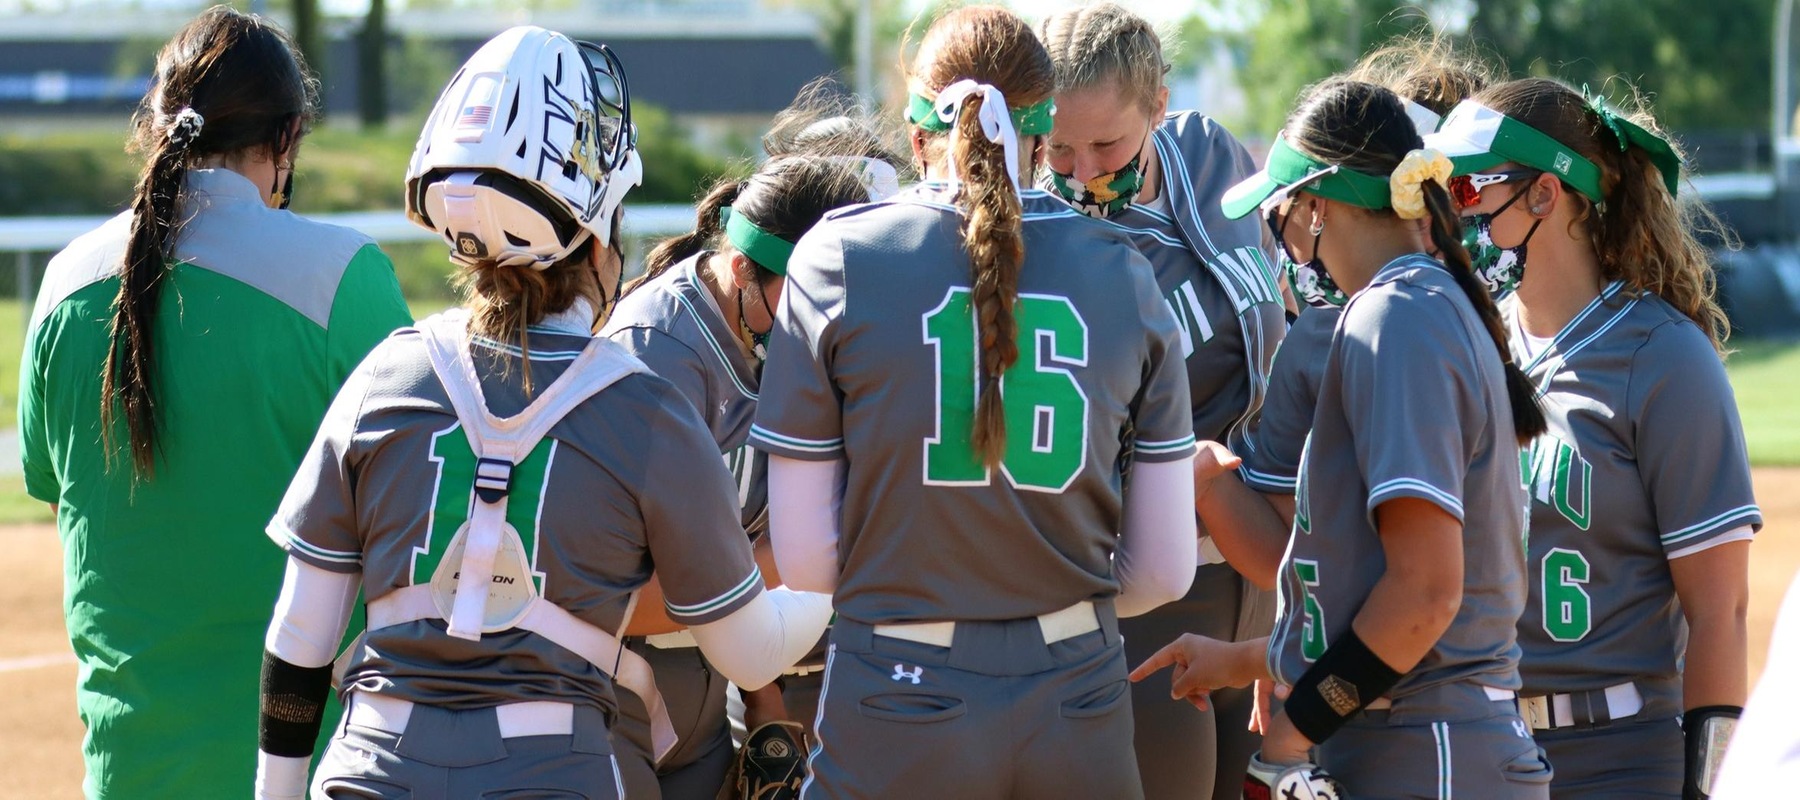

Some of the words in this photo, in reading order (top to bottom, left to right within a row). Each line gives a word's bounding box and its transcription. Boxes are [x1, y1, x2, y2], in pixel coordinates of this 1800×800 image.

[922, 285, 1089, 494] 16
[453, 571, 515, 585] EON
[1293, 557, 1329, 664] 5
[1541, 547, 1592, 643] 6
